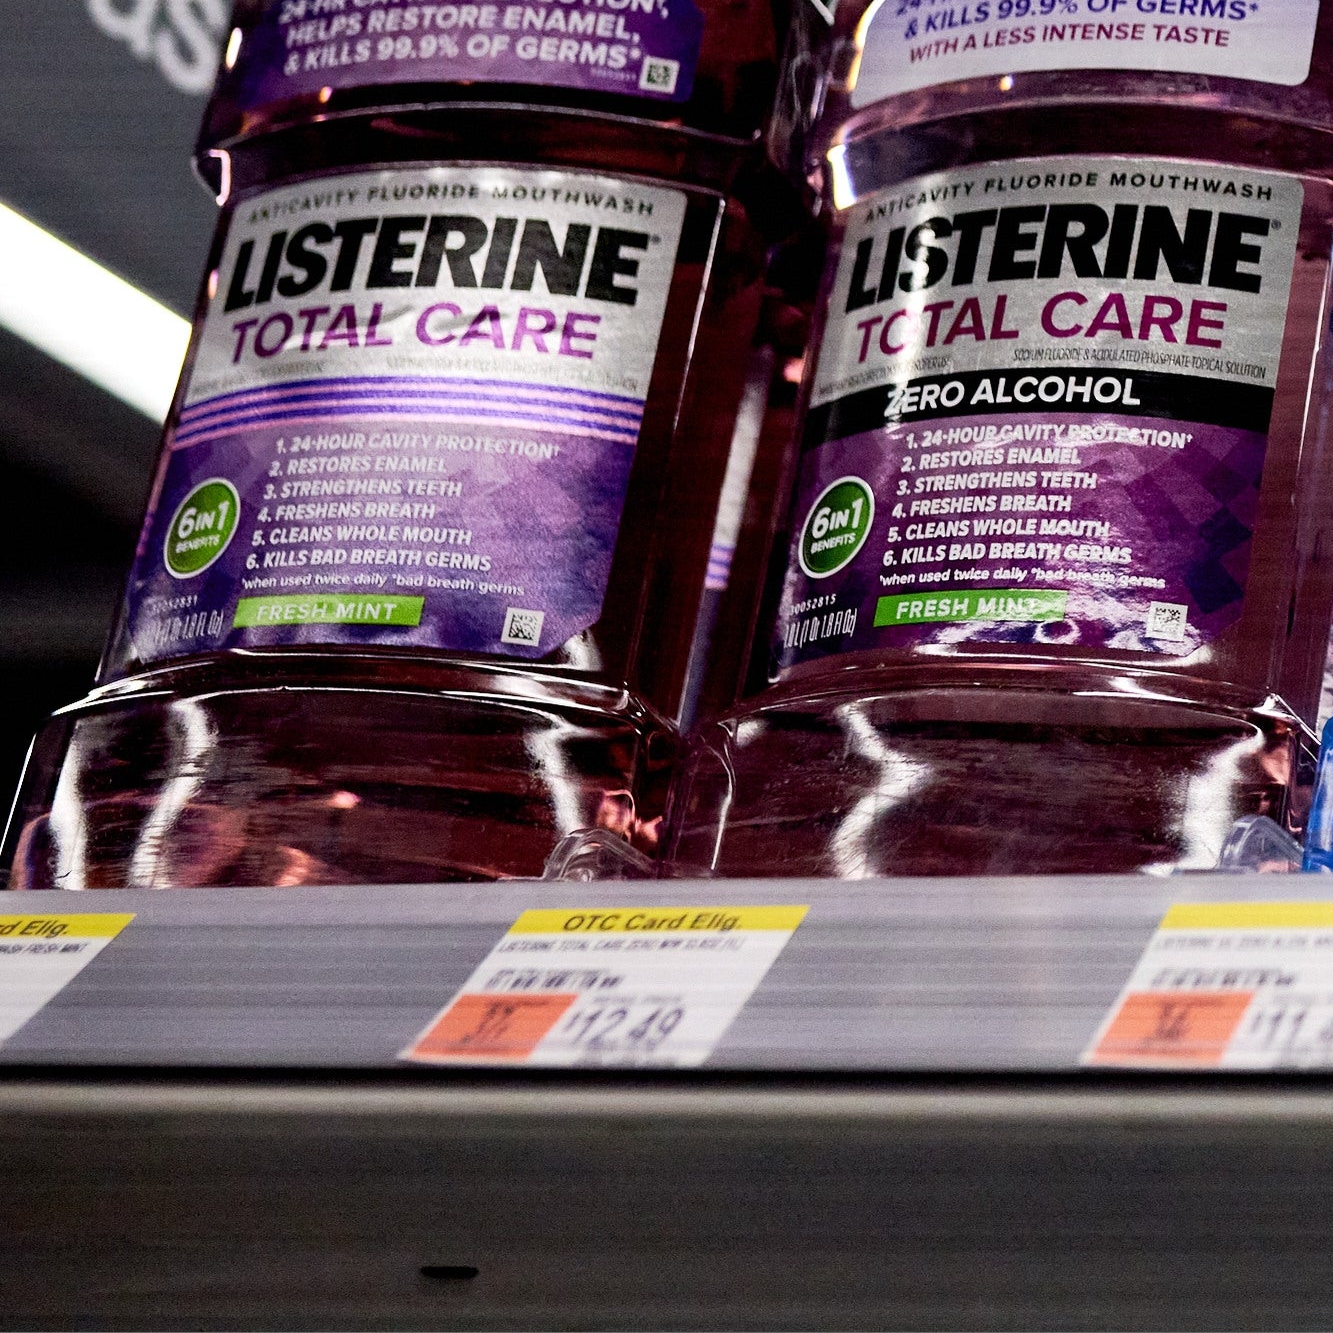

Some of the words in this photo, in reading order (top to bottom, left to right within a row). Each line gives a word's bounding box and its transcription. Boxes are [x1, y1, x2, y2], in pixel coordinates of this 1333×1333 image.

[286, 12, 363, 48] HELPS
[367, 5, 498, 33] RESTORE
[503, 6, 641, 43] ENAMEL,
[904, 19, 918, 41] &
[283, 55, 297, 76] &
[305, 37, 371, 71] KILLS
[377, 36, 459, 60] 99.9%
[466, 34, 510, 58] OF
[909, 39, 958, 65] WITH
[961, 35, 978, 52] A
[983, 26, 1035, 48] LESS
[1041, 23, 1144, 43] INTENSE
[1152, 24, 1230, 48] TASTE
[247, 188, 361, 224] ANTICAVITY
[367, 184, 480, 203] FLUORIDE
[493, 186, 655, 216] MOUTHWASH
[865, 183, 975, 223] ANTICAVITY
[983, 172, 1099, 193] FLUORIDE
[1109, 172, 1273, 202] MOUTHWASH
[223, 214, 649, 312] LISTERINE
[231, 302, 393, 364] TOTAL
[415, 302, 602, 360] CARE
[855, 293, 1021, 364] TOTAL
[1040, 290, 1229, 349] CARE
[1191, 354, 1225, 374] TOPICAL
[1226, 360, 1266, 379] SOLUTION
[883, 379, 965, 417] ZERO
[970, 377, 1141, 406] ALCOHOL
[919, 448, 1004, 470] RESTORES
[1007, 447, 1082, 465] ENAMEL
[914, 473, 1037, 493] STRENGTHENS
[1040, 472, 1098, 490] TEETH
[910, 496, 996, 516] FRESHENS
[999, 495, 1071, 513] BREATH
[905, 520, 970, 540] CLEANS
[973, 520, 1036, 536] WHOLE
[1038, 519, 1110, 538] MOUTH
[810, 534, 856, 554] BENEFITS
[900, 545, 946, 564] KILLS
[948, 544, 986, 562] BAD
[989, 543, 1062, 561] BREATH
[1064, 544, 1132, 563] GERMS
[257, 601, 330, 622] FRESH
[335, 602, 398, 621] MINT
[896, 600, 968, 620] FRESH
[563, 915, 620, 931] OTC
[624, 914, 688, 931] Card
